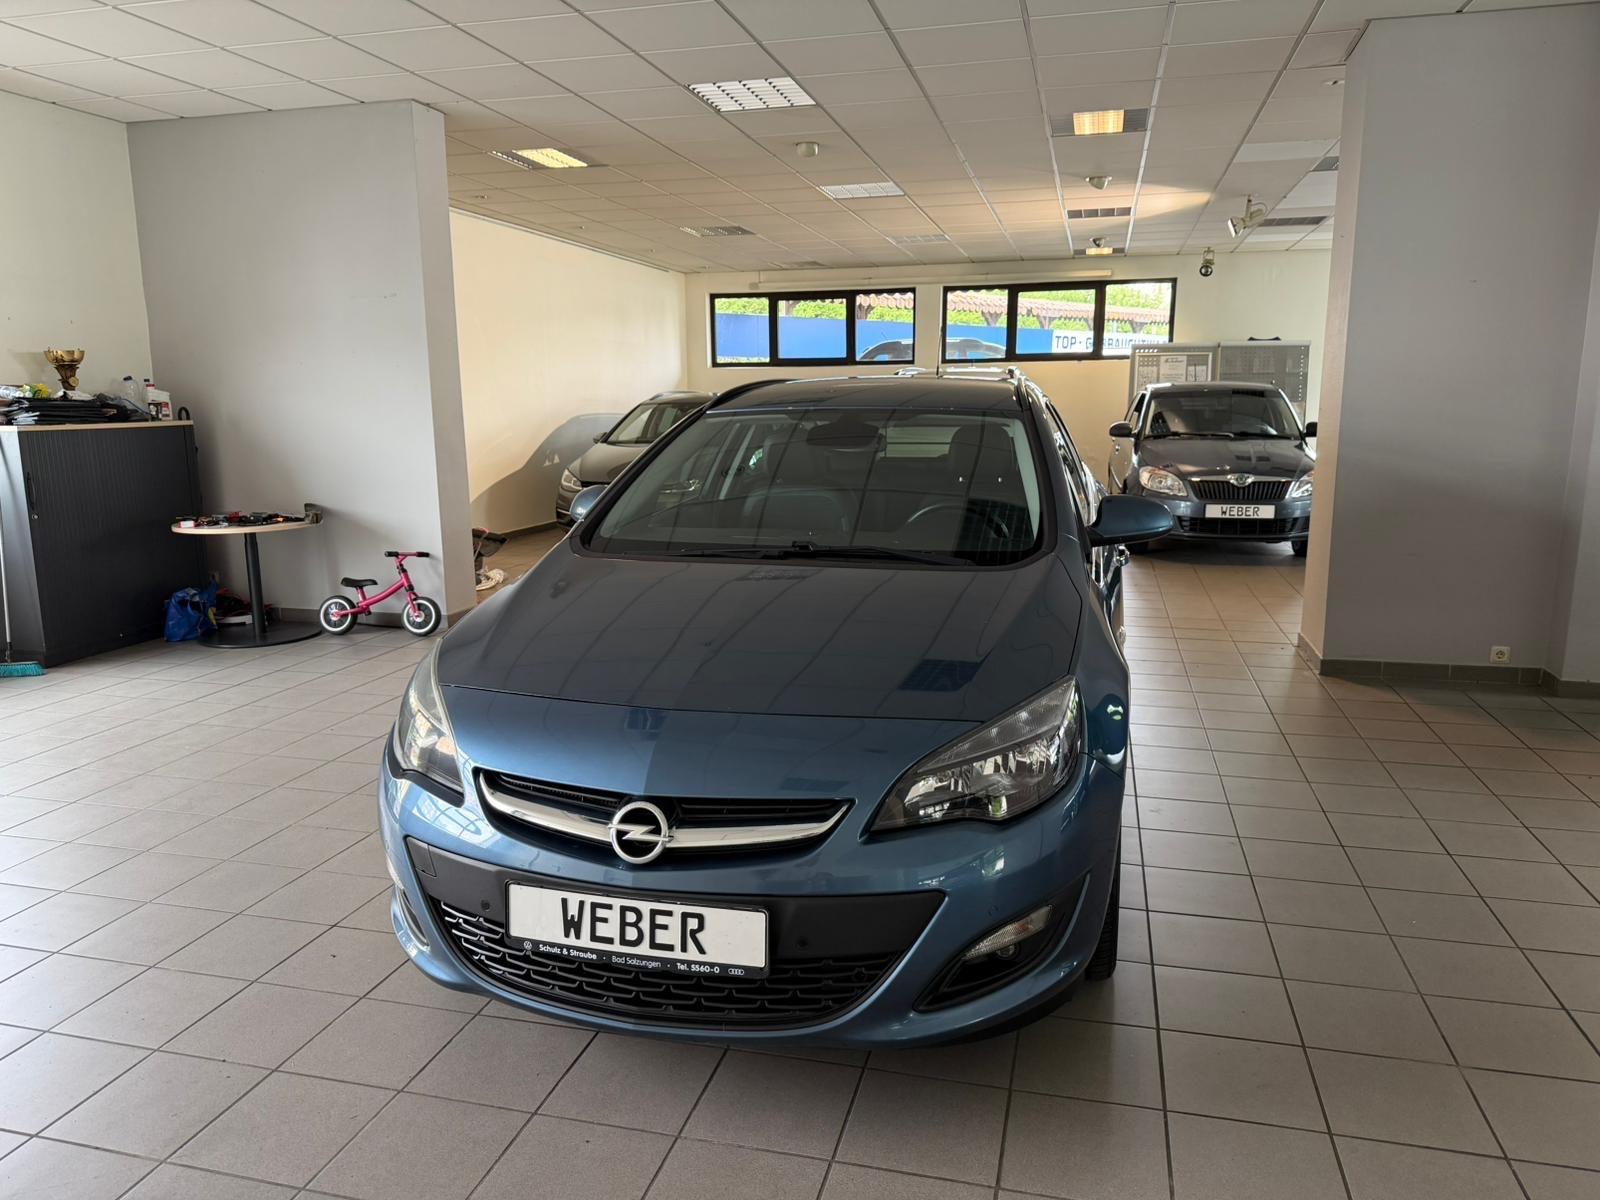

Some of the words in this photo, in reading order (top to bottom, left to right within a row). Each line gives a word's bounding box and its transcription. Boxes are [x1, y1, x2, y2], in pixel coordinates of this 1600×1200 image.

[1055, 335, 1077, 349] TOP
[1220, 506, 1260, 517] WEBER
[561, 897, 707, 955] WEBER
[539, 944, 561, 954] Schulz
[569, 949, 597, 960] Straube
[611, 955, 625, 964] Bad
[626, 957, 661, 969] Salzungen
[676, 962, 689, 971] Tel.
[690, 964, 720, 974] 5560-0
